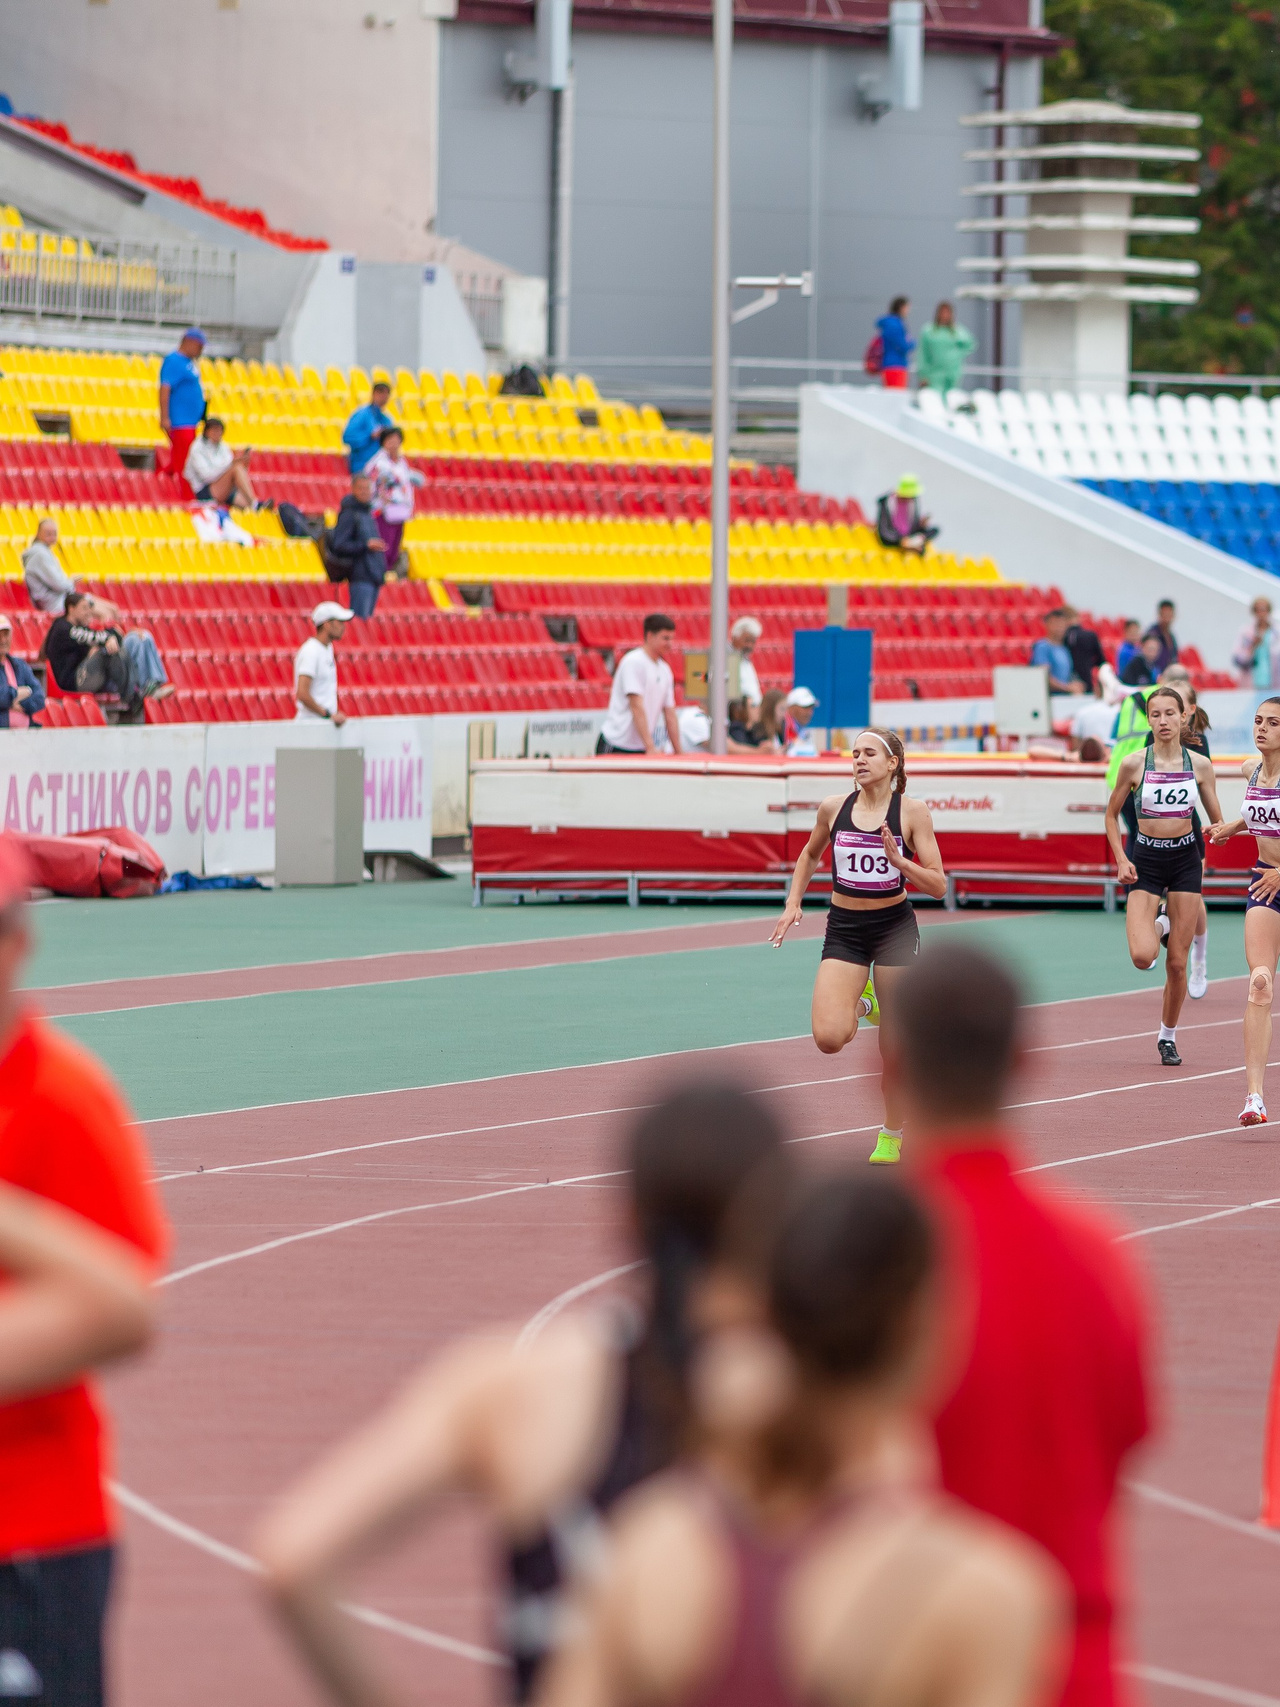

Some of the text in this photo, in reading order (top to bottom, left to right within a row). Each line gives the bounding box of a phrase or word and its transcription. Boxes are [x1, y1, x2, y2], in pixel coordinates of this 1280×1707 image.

[1153, 788, 1189, 805] 162
[1248, 805, 1280, 824] 284
[847, 853, 889, 874] 103
